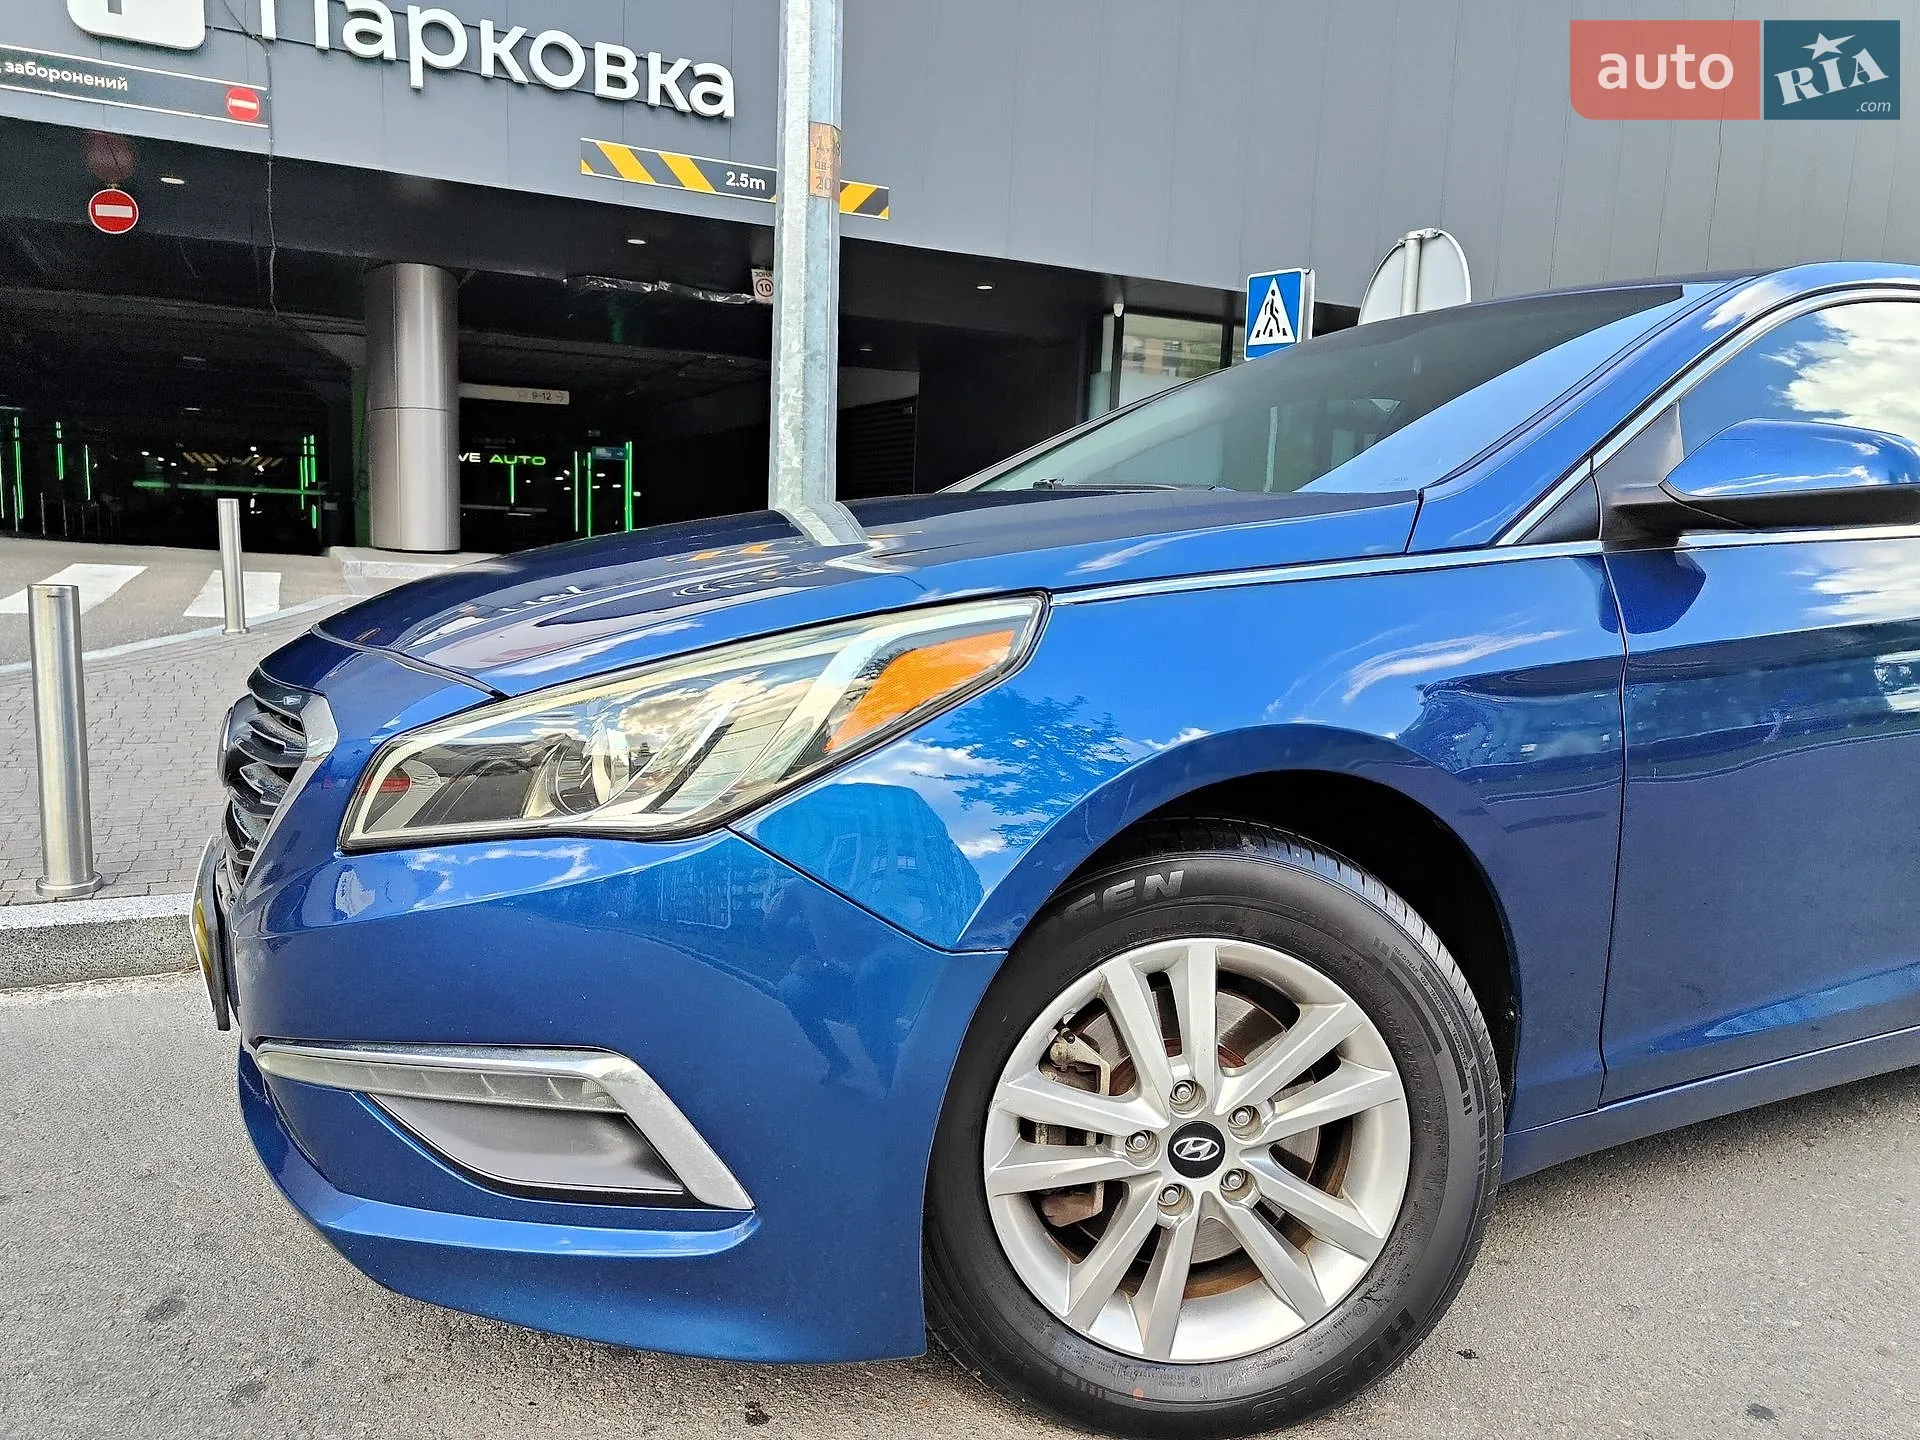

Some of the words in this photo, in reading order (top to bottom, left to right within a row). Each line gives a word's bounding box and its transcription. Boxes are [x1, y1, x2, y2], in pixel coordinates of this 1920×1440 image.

[5, 61, 129, 91] заборонений
[726, 170, 766, 190] 2.5m
[759, 283, 772, 293] 10
[489, 454, 547, 466] AUTO
